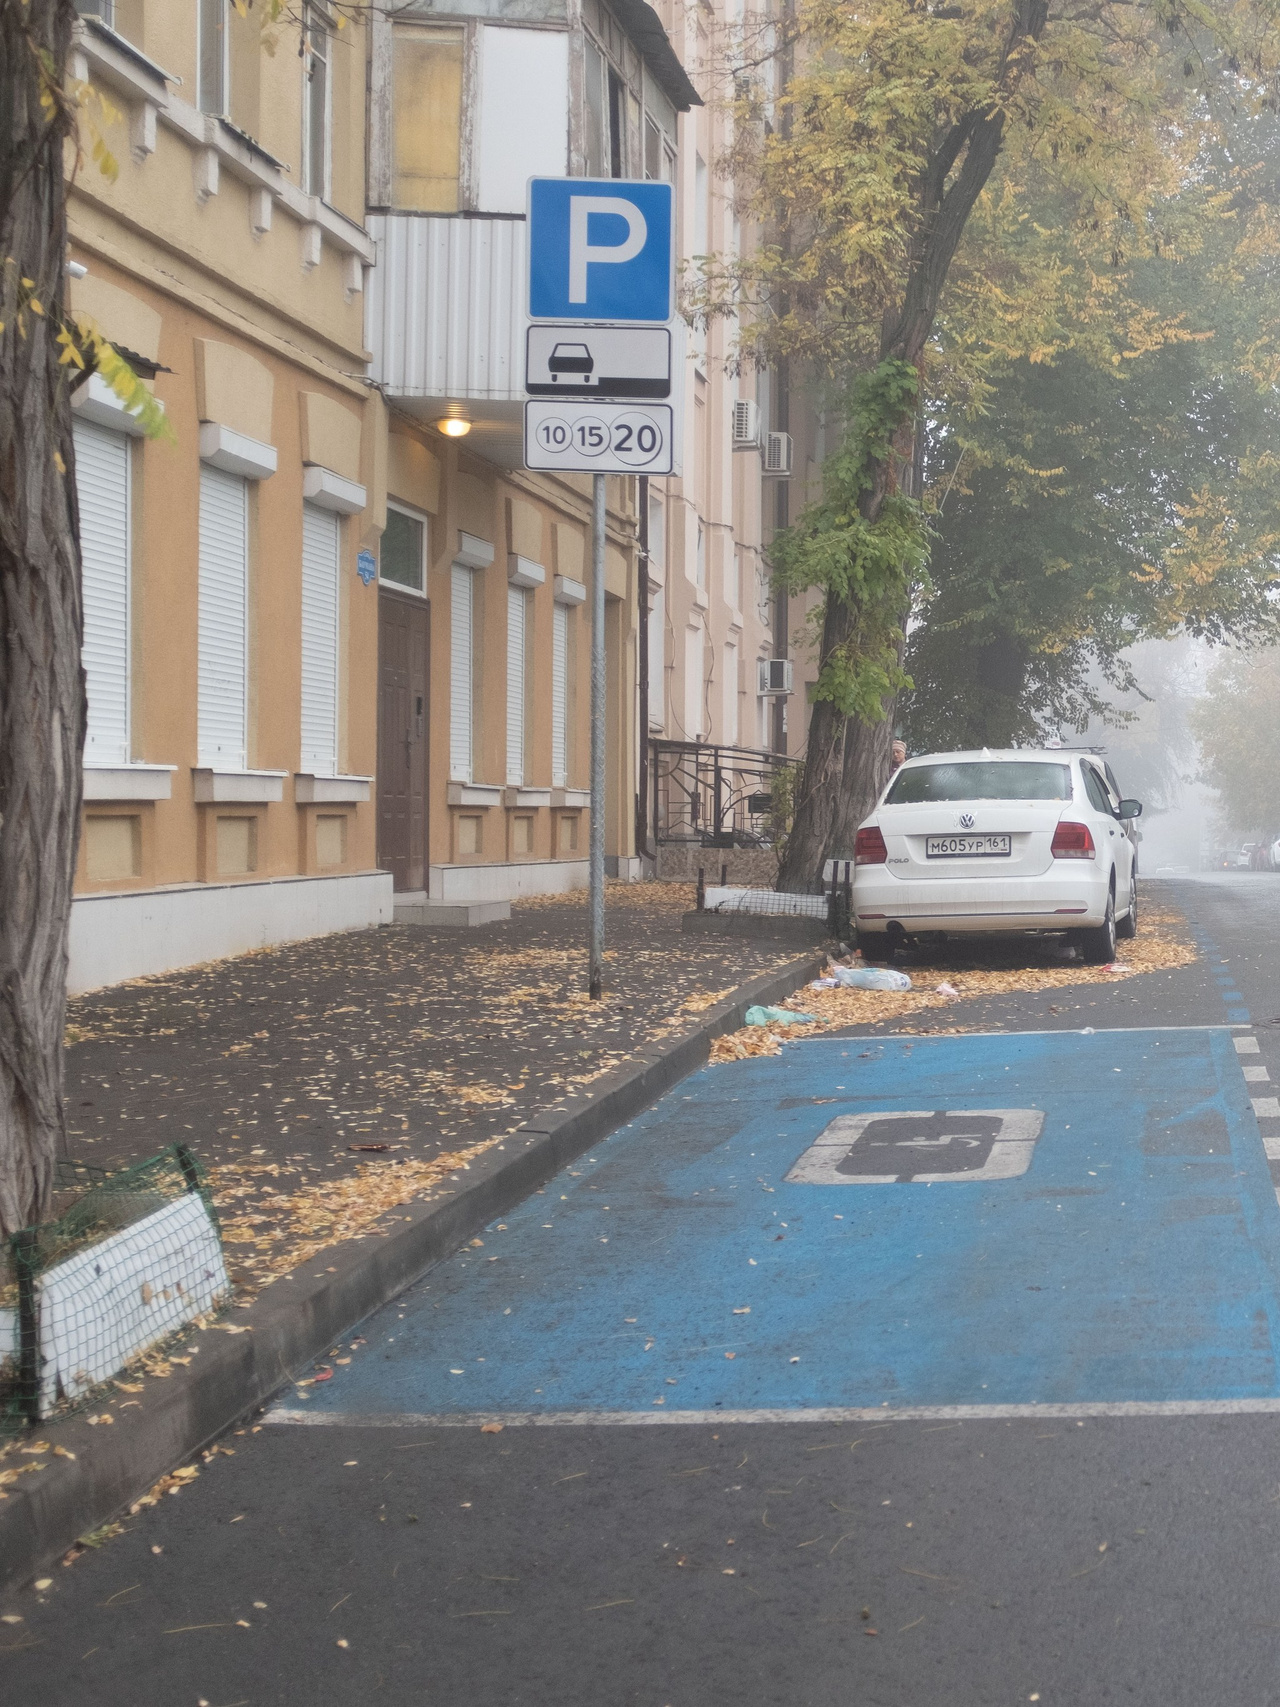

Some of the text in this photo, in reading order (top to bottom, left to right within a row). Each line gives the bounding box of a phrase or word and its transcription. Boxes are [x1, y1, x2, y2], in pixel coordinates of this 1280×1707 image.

[568, 195, 648, 304] P
[542, 423, 657, 453] 10 15 20
[986, 837, 1006, 848] 161
